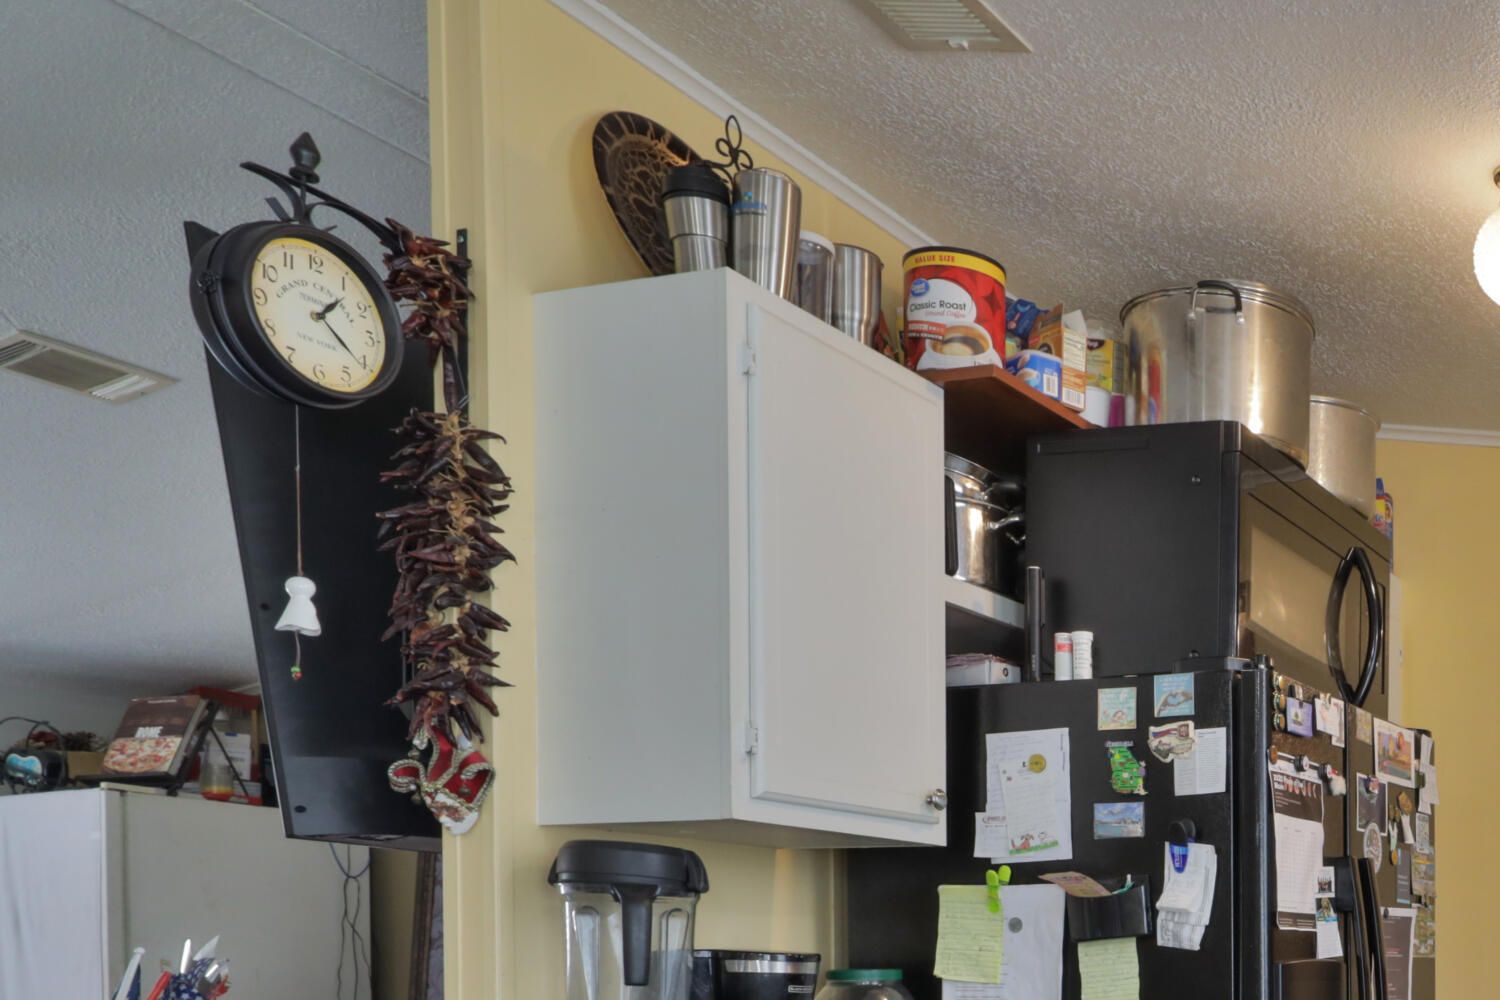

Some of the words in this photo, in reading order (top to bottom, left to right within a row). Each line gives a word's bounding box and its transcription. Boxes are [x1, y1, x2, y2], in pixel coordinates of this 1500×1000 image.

[262, 263, 279, 283] 10
[309, 254, 324, 274] 12
[341, 275, 347, 291] 1
[253, 288, 268, 306] 9
[276, 279, 308, 299] GRAND
[312, 281, 355, 325] CENRAL
[909, 299, 937, 313] Classic
[939, 300, 967, 311] Roast
[356, 302, 368, 319] 2
[263, 318, 277, 337] 8
[296, 331, 314, 344] NEW
[316, 339, 338, 352] YORK
[364, 330, 375, 348] 3
[285, 345, 296, 363] 7
[312, 364, 326, 380] 6
[340, 365, 351, 382] 5
